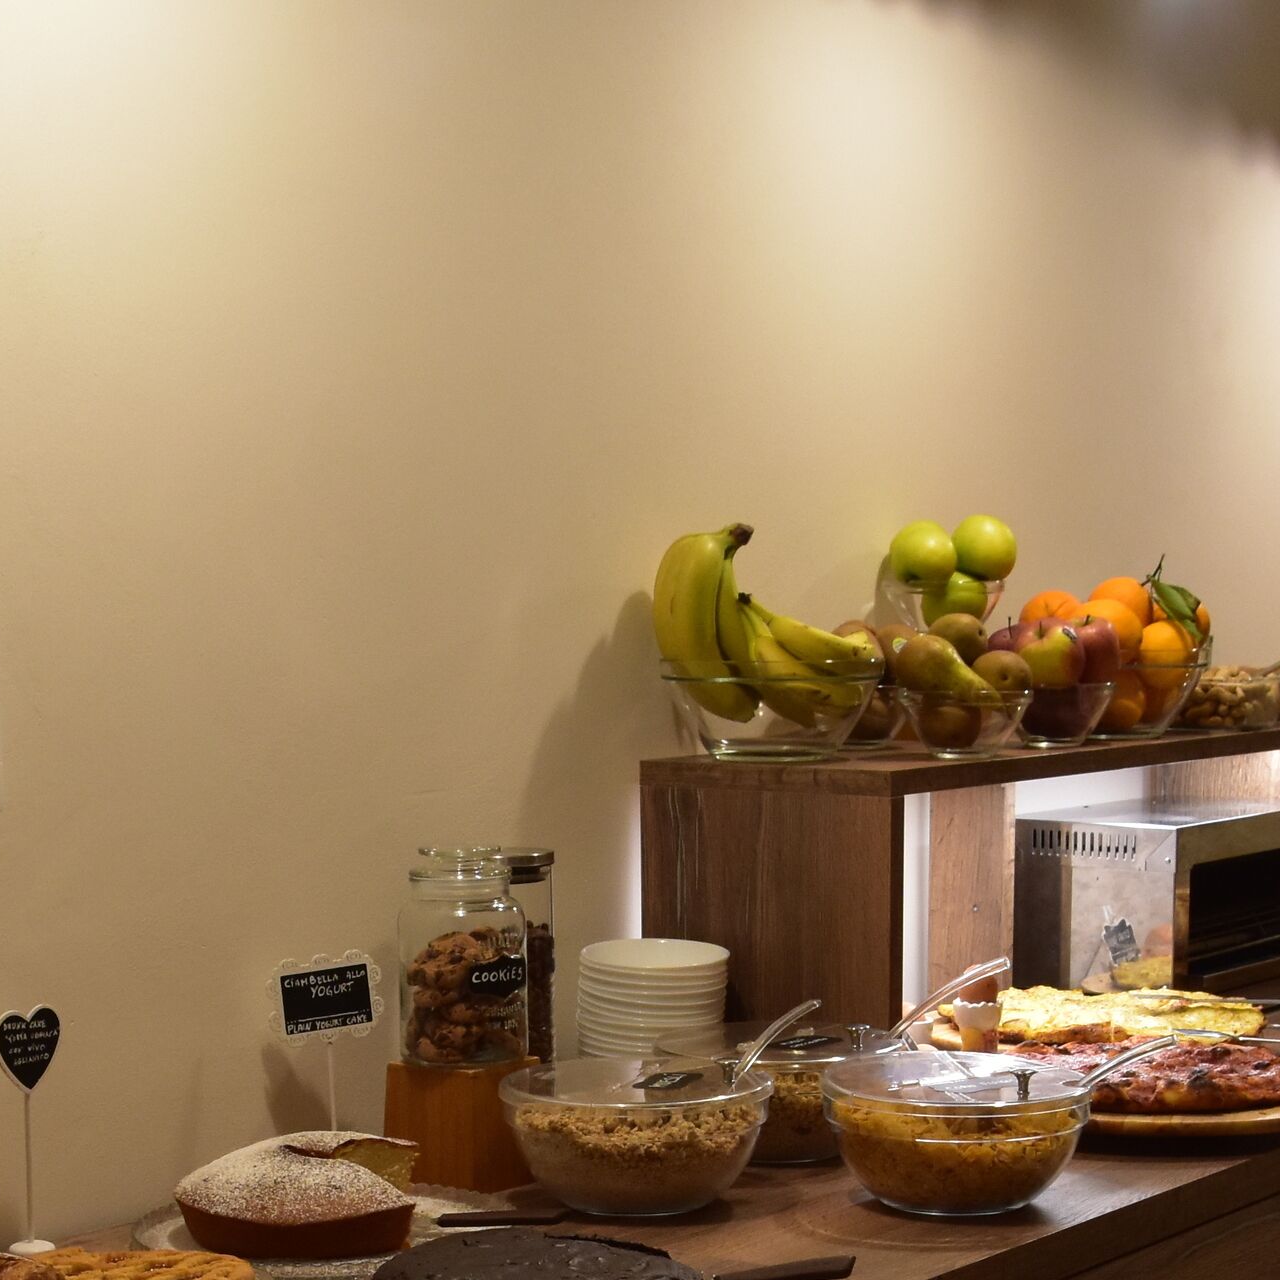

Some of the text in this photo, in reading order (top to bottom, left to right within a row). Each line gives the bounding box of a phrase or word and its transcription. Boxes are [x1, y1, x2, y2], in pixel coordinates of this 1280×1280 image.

[310, 981, 354, 998] YOGURT
[287, 1014, 368, 1035] PLAIN YOGURT CAKE
